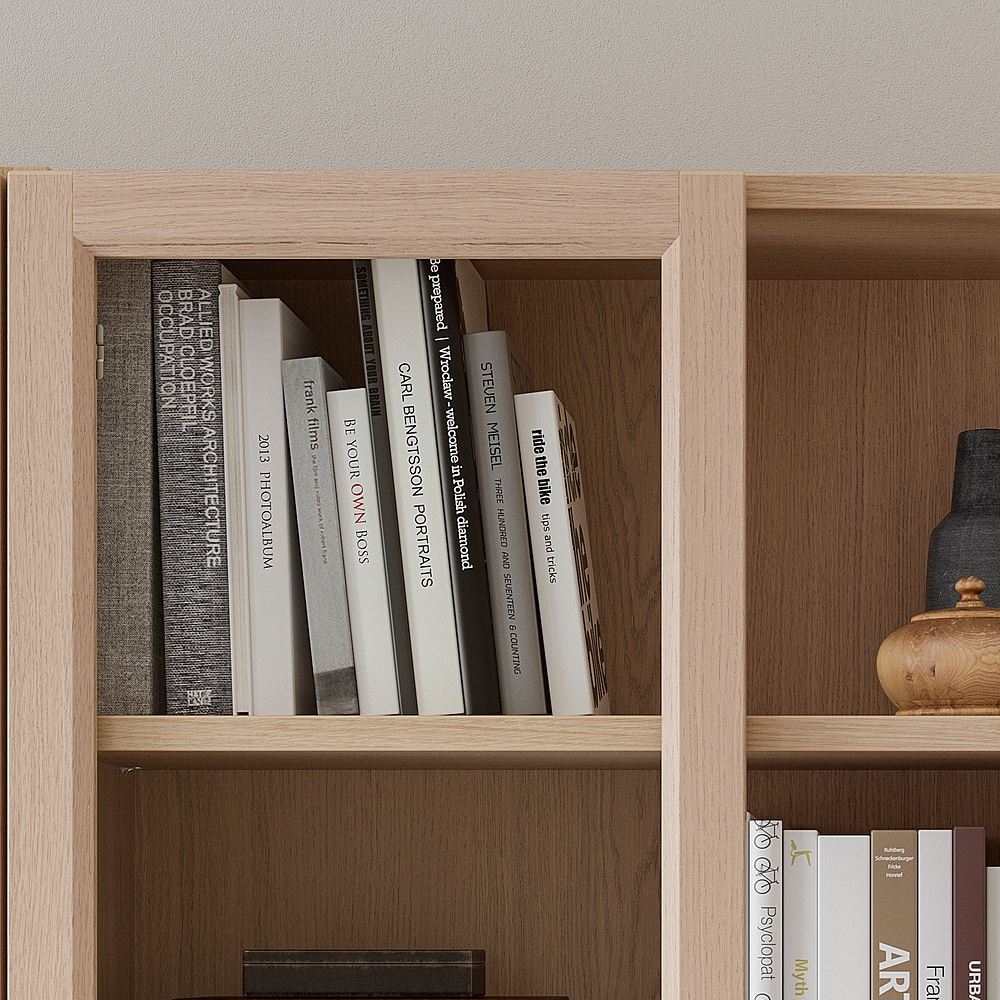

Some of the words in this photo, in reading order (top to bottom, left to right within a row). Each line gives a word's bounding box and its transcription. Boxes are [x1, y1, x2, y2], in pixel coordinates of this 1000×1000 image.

[178, 290, 194, 339] BRAD
[355, 267, 371, 321] SOMETHING
[428, 275, 448, 331] prepared
[198, 290, 214, 350] ALLIED
[362, 324, 375, 355] ABOUT
[159, 290, 176, 409] OCCUPATION
[181, 345, 197, 432] CLOEPFIL
[200, 357, 216, 421] WORKS
[365, 359, 378, 384] YOUR
[398, 363, 413, 401] CARL
[437, 346, 453, 399] Wroclaw
[481, 362, 496, 413] STEVEN
[304, 380, 318, 414] frank
[368, 387, 381, 417] BRAIN
[258, 434, 270, 463] 2013
[307, 418, 321, 450] films
[403, 406, 424, 497] BENGTSSON
[444, 408, 460, 463] welcome
[486, 422, 502, 471] MEISEL
[531, 429, 546, 454] ride
[347, 439, 360, 480] YOUR
[451, 465, 462, 477] in
[534, 456, 549, 477] the
[202, 427, 220, 567] ARCHITECTURE
[350, 483, 367, 525] OWN
[452, 478, 468, 514] Polish
[494, 478, 504, 503] THREE
[537, 478, 552, 505] bike
[259, 472, 273, 569] PHOTOALBUM
[497, 508, 509, 548] HUNDRED
[541, 513, 551, 532] tips
[413, 504, 434, 588] PORTRAITS
[457, 516, 473, 570] diamond
[501, 552, 510, 570] AND
[544, 535, 554, 553] and
[547, 556, 558, 584] tricks
[503, 573, 516, 620] SEVENTEEN
[510, 632, 522, 675] COUNTING
[756, 906, 777, 981] Psyclopat
[791, 958, 809, 996] Myth
